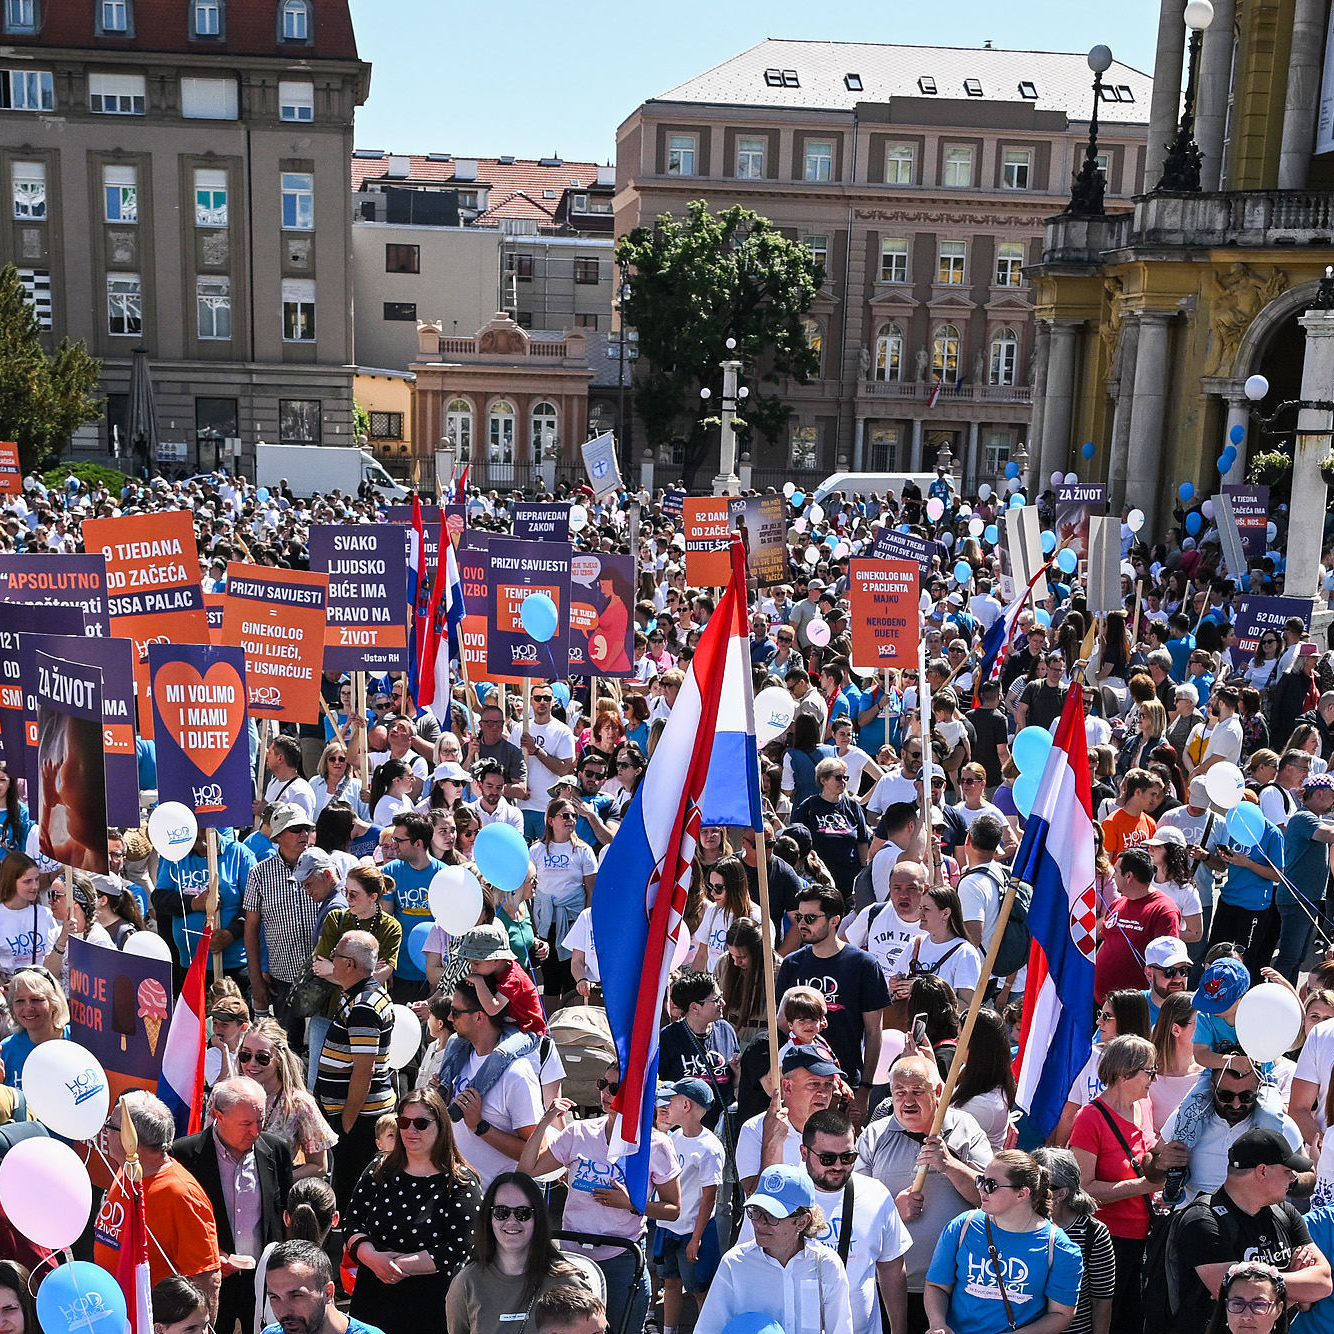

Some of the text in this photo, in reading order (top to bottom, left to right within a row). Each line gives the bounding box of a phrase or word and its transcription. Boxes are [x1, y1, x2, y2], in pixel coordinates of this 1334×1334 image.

[1058, 485, 1102, 502] ZA ŽIVOT
[516, 511, 568, 521] NEPRAVEDAN
[695, 512, 706, 522] 52
[528, 522, 555, 532] ZAKON
[691, 527, 703, 536] OD
[102, 539, 182, 560] 9 TJEDANA
[334, 535, 377, 551] SVAKO
[687, 541, 713, 551] DIJETE
[886, 533, 926, 551] ZAKON TREBA
[899, 547, 910, 557] SVE
[910, 551, 929, 563] LJUDE
[328, 559, 386, 575] LJUDSKO
[490, 557, 568, 572] PRIZIV SAVIJESTI
[129, 561, 187, 585] ZAČEĆA
[463, 567, 485, 580] OVO
[856, 571, 914, 582] GINEKOLOG IMA
[230, 581, 322, 604] PRIZIV SAVIJESTI
[329, 580, 387, 598] BIĆE IMA
[862, 583, 908, 593] 2 PACIJENTA
[108, 591, 193, 615] SISA PALAC
[873, 595, 899, 604] MAJKU
[326, 607, 391, 622] PRAVO NA
[1256, 613, 1267, 622] 52
[241, 621, 304, 641] GINEKOLOG
[340, 627, 378, 645] ŽIVOT
[874, 629, 899, 638] DIJETE
[464, 633, 485, 647] OVO
[240, 640, 302, 662] KOJI LIJEČI,
[361, 654, 400, 664] -Ustav RH
[254, 659, 313, 680] USMRĆUJE
[38, 665, 95, 709] ZA ŽIVOT
[166, 684, 235, 703] MI VOLIMO
[248, 686, 281, 701] HOD
[187, 708, 228, 726] MAMU
[188, 732, 230, 749] DIJETE
[70, 968, 107, 1003] OVO JE
[71, 1001, 103, 1032] IZBOR
